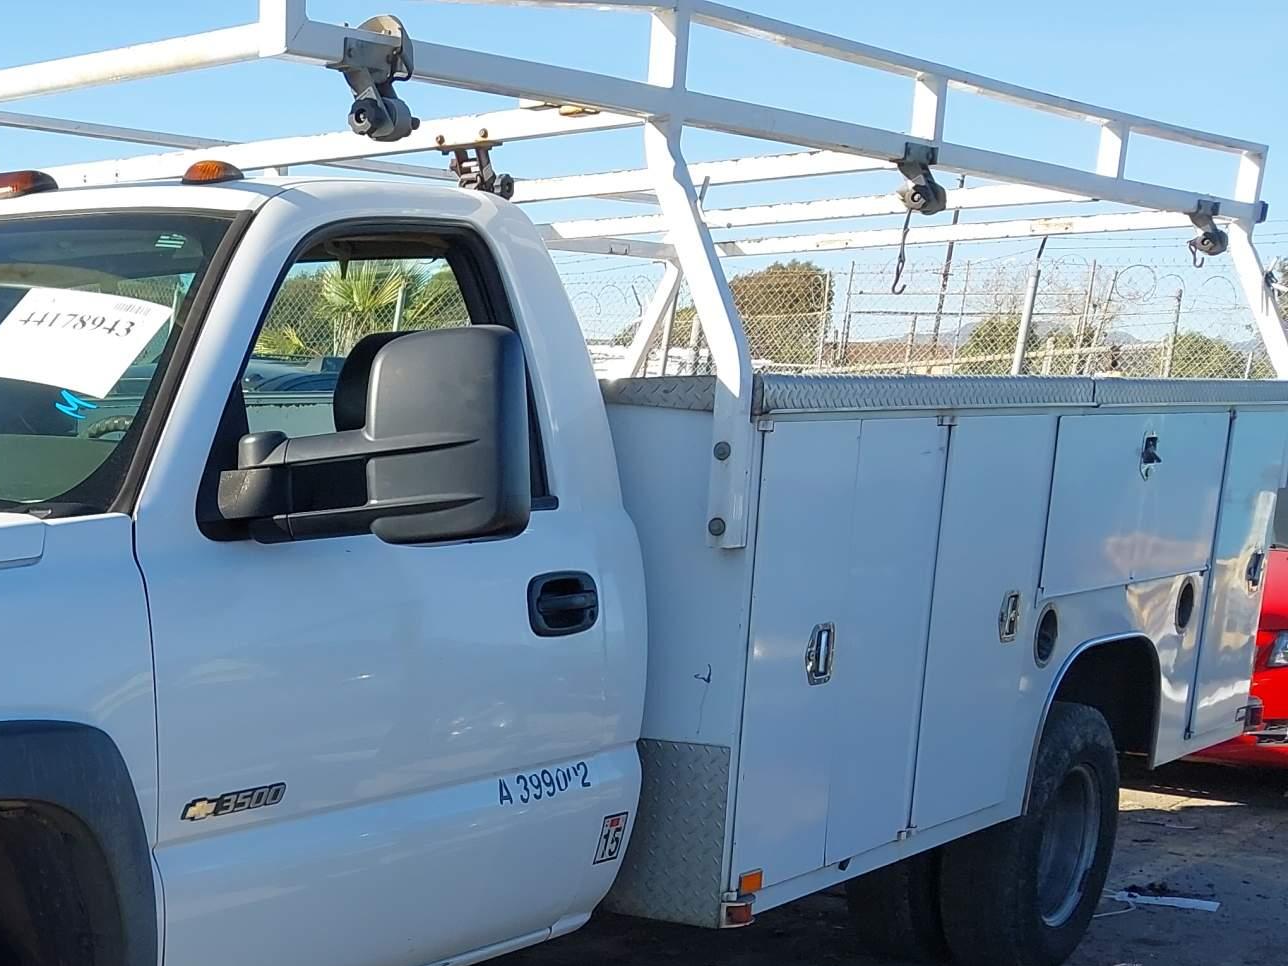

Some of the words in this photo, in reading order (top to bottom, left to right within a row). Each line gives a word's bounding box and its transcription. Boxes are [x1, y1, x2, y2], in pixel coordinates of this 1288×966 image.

[18, 311, 136, 337] 44178943
[217, 785, 285, 815] 3500
[600, 826, 623, 859] 15
